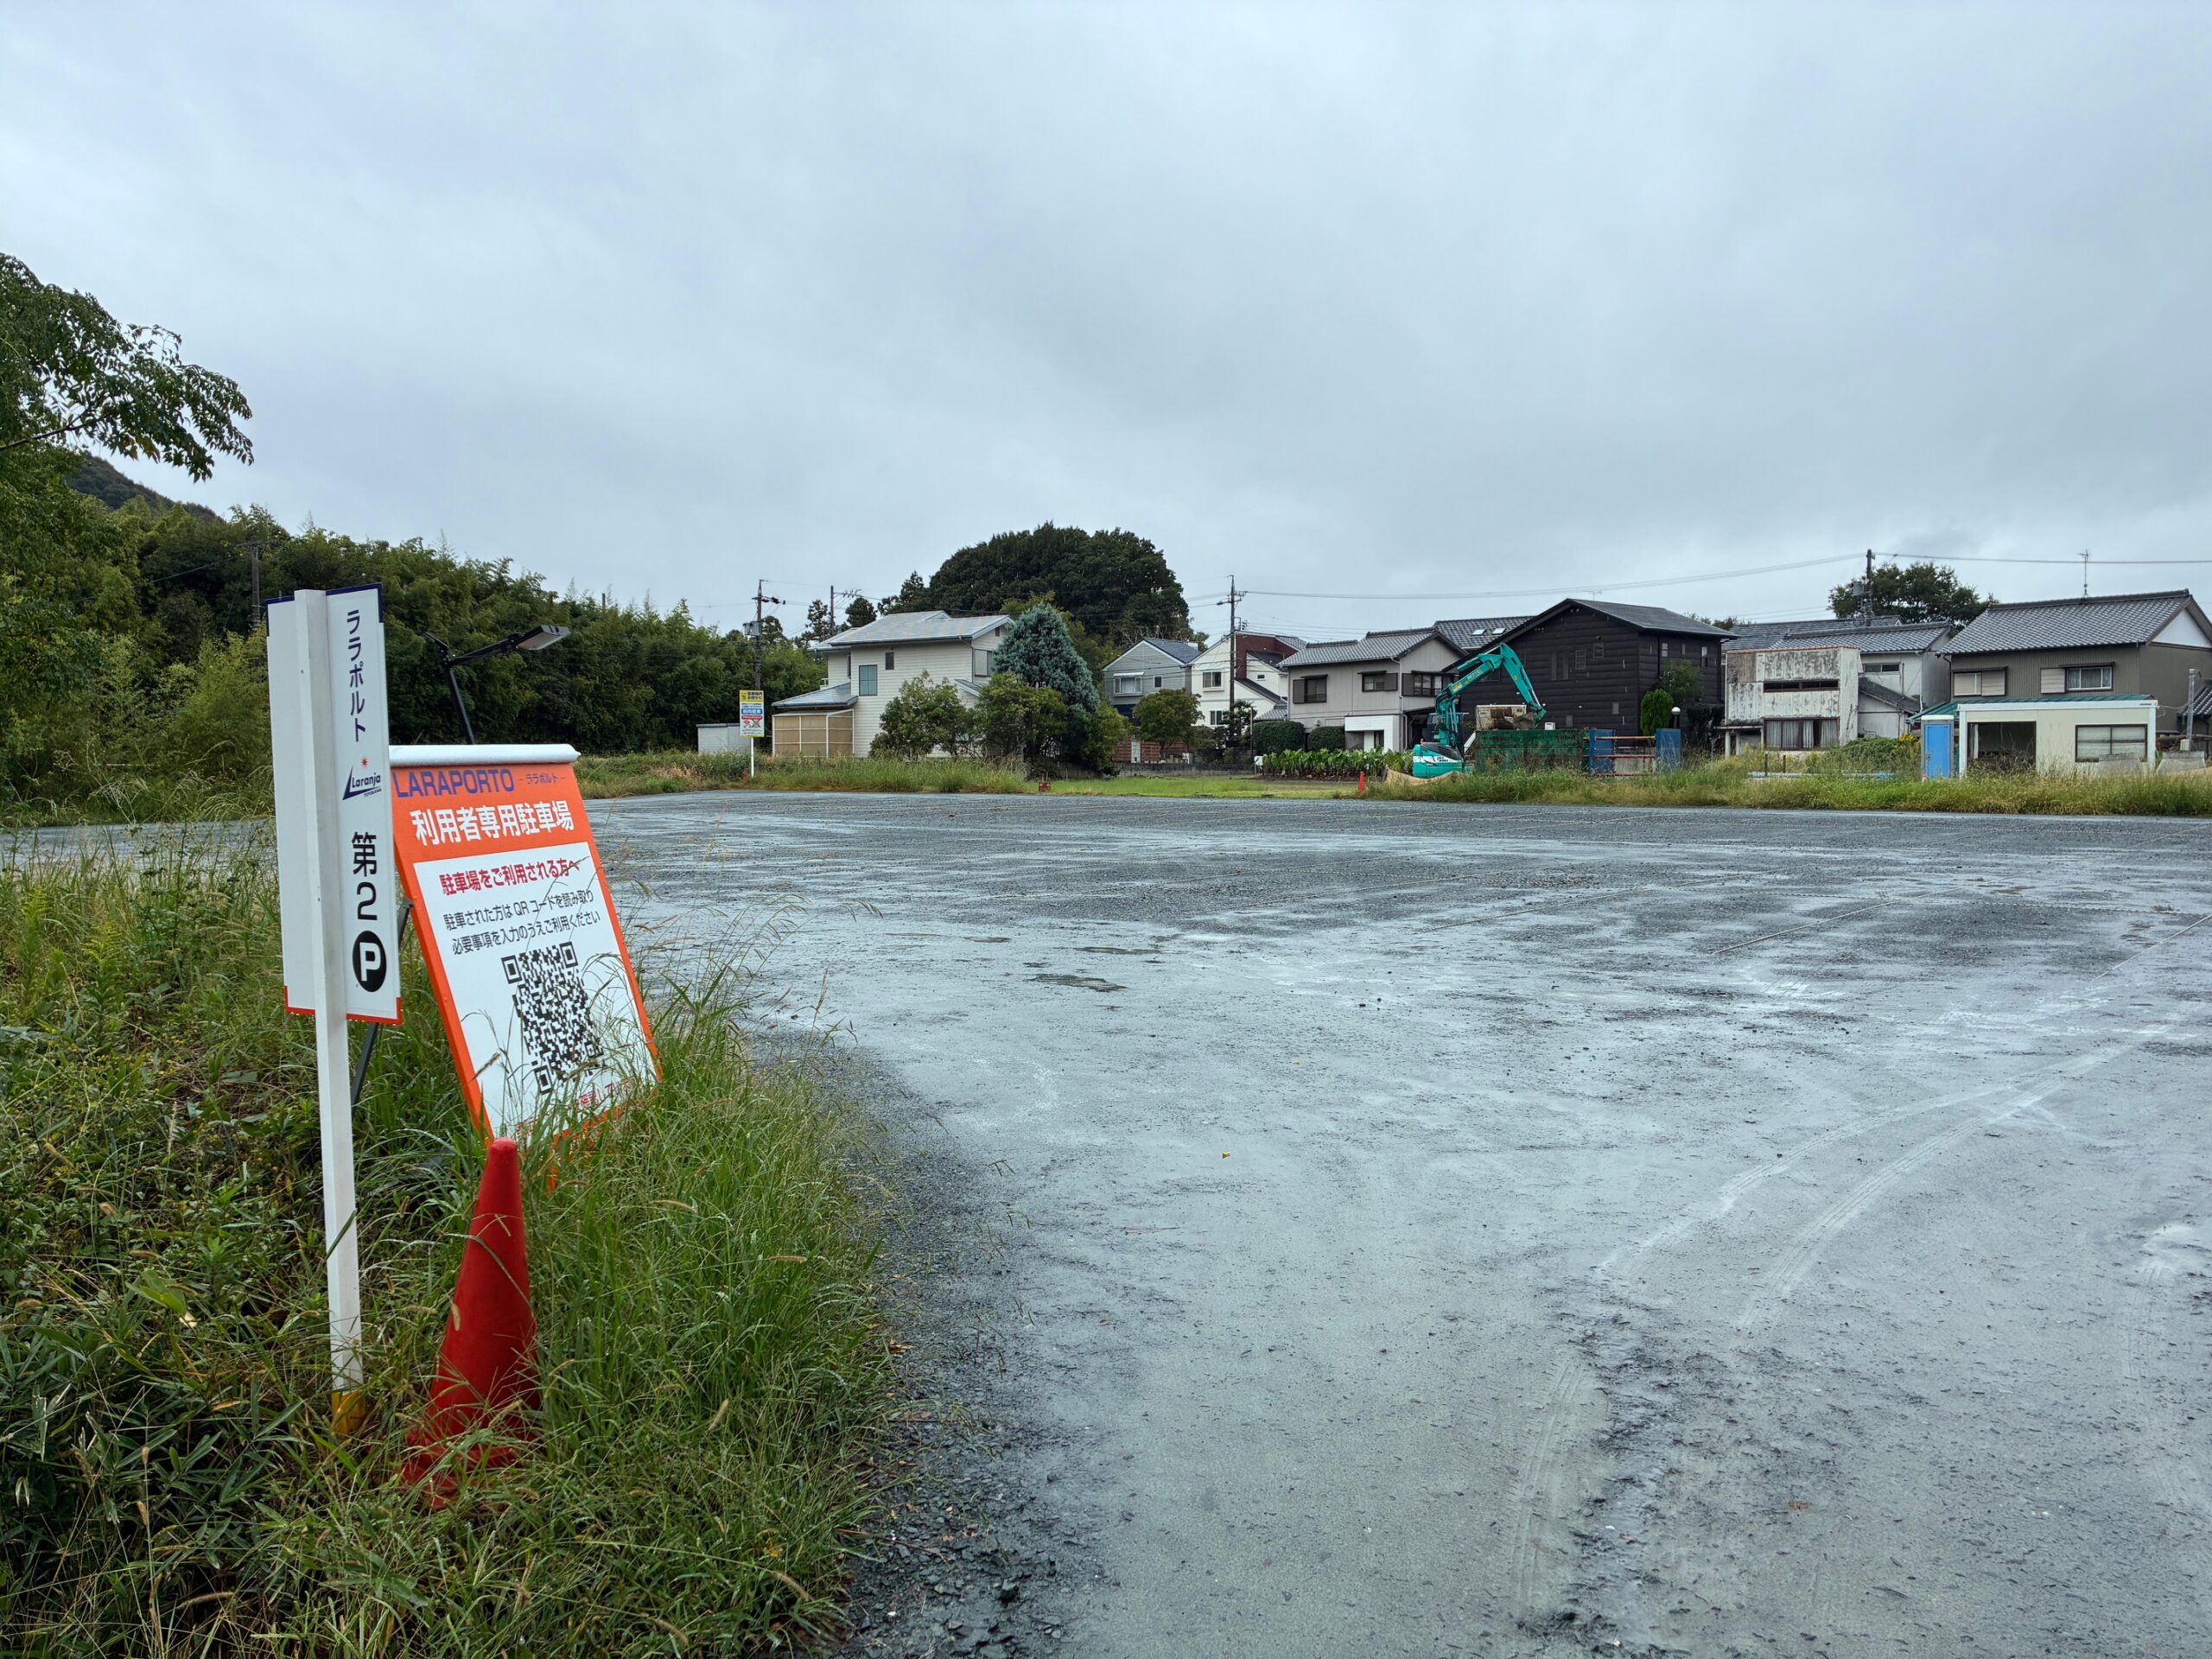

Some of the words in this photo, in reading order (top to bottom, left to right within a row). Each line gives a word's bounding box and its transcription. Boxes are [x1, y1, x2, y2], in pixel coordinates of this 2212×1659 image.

[346, 609, 366, 742] ララポルト
[352, 772, 381, 788] Laranja
[393, 768, 515, 798] LARAPORTO
[410, 799, 575, 846] 利用者専用駐車場
[439, 857, 581, 896] 駐車場をご利用される方へ
[452, 910, 601, 955] 必要事項を入力のうえご利用ください
